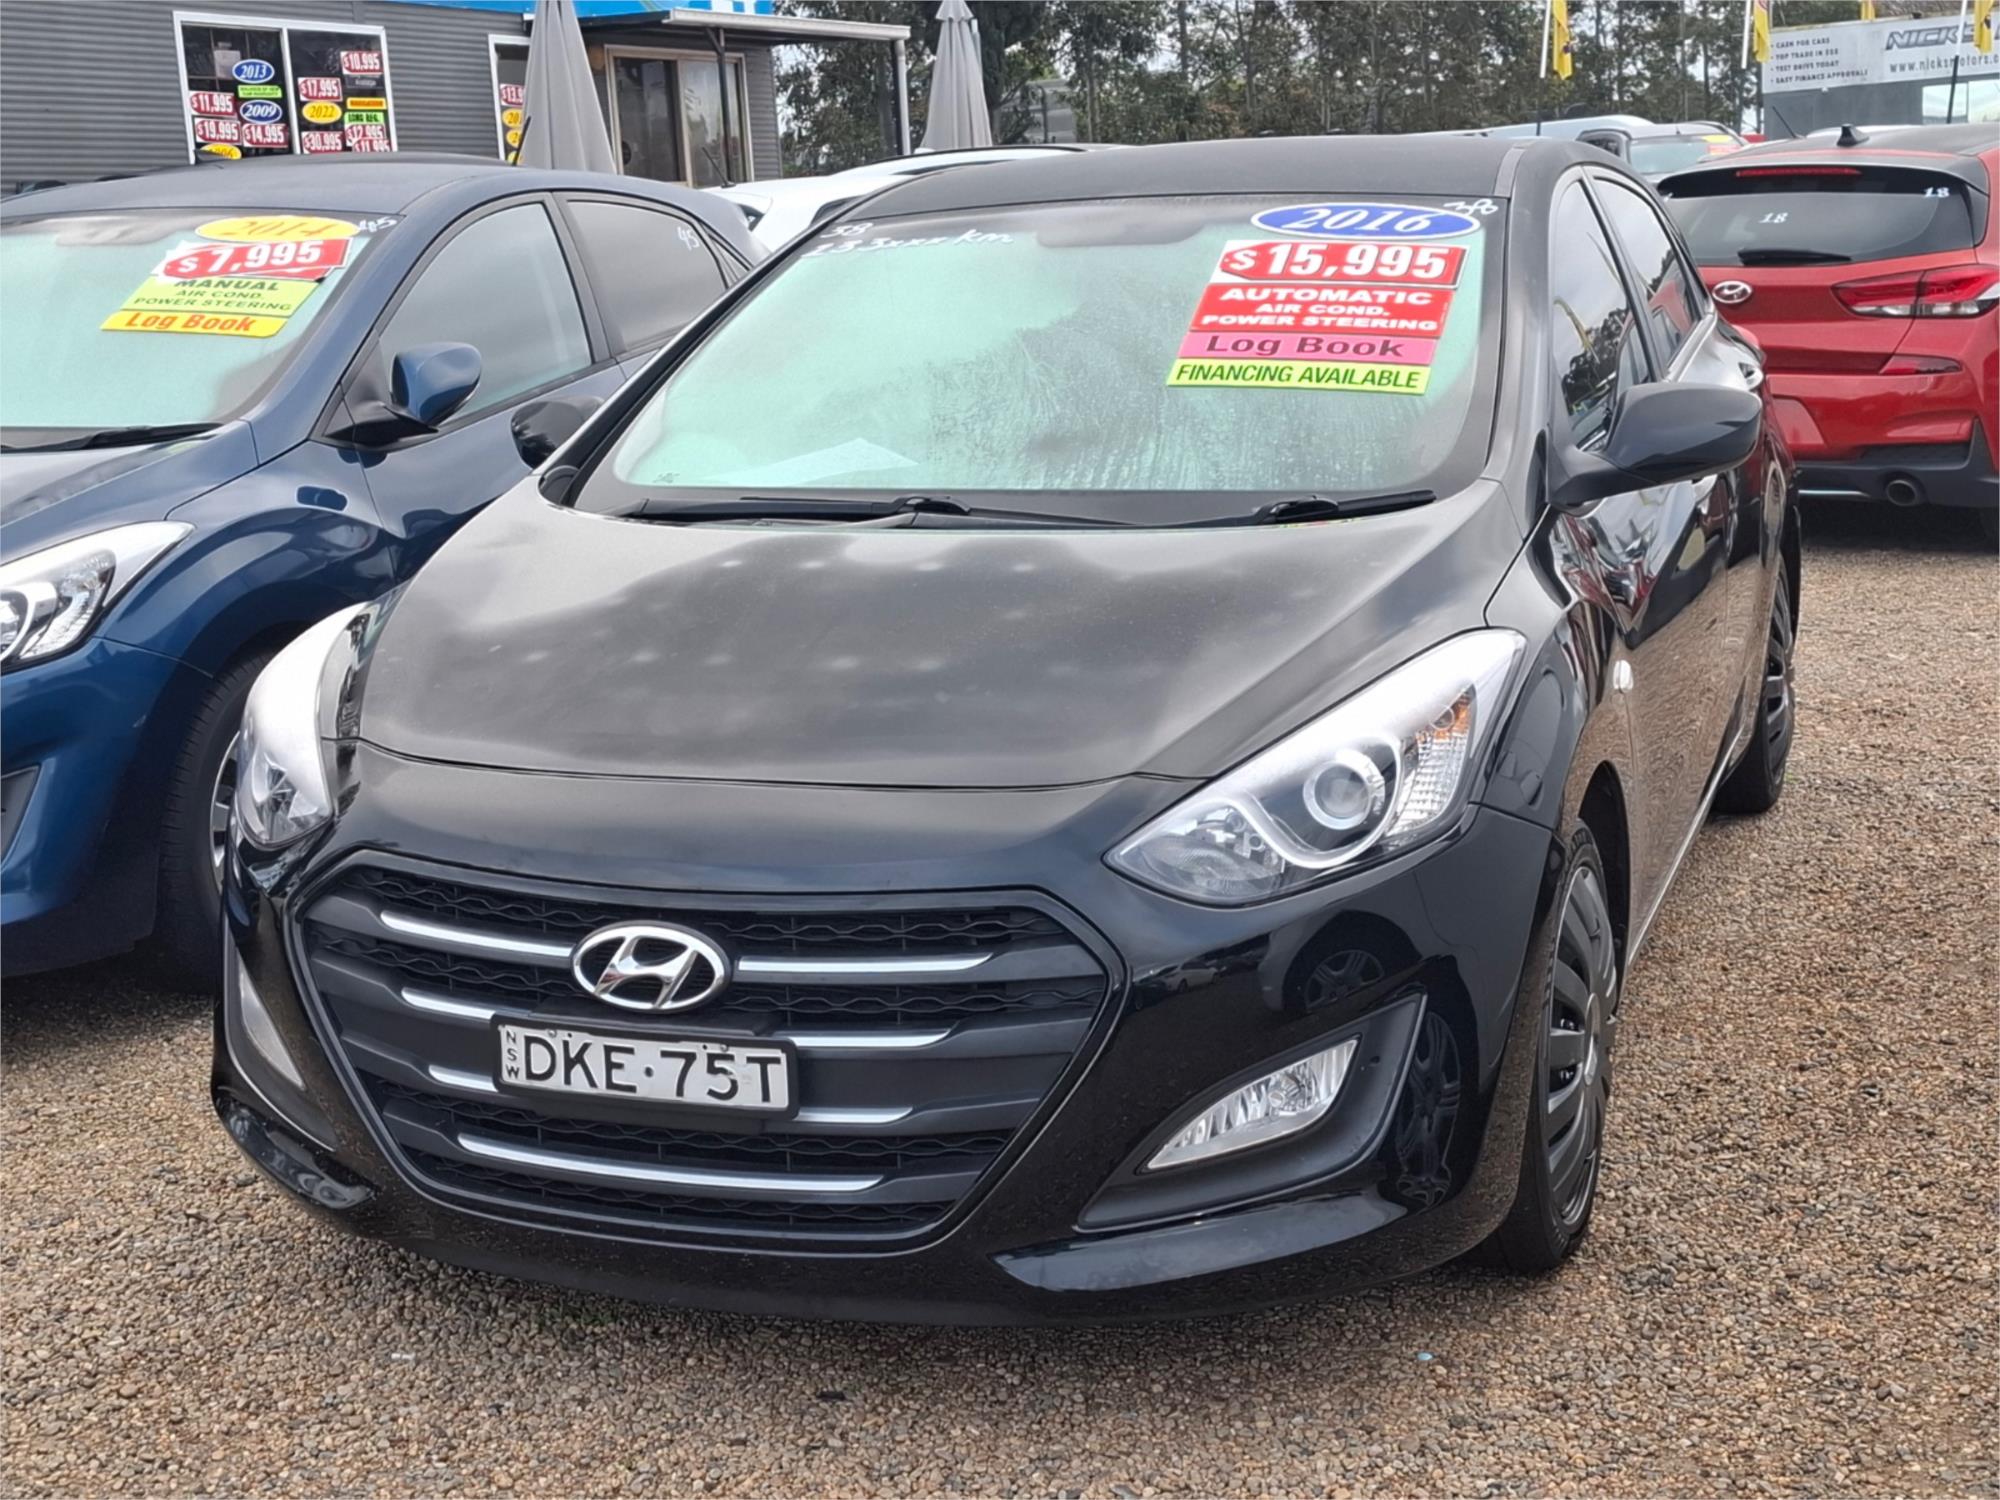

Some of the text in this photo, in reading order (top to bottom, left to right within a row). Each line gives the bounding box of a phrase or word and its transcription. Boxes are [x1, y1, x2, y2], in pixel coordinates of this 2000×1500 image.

[241, 64, 268, 79] 2013
[301, 79, 339, 98] $17,995
[191, 93, 233, 113] $11,995
[245, 104, 277, 118] 2009
[309, 105, 336, 119] 2022
[196, 120, 239, 141] $19,995
[244, 125, 285, 144] $14,995
[1924, 186, 1950, 199] 18
[1281, 208, 1448, 233] 2016
[1758, 212, 1788, 224] 18
[221, 220, 338, 238] 2014
[173, 279, 280, 291] MANUAL
[175, 289, 207, 297] AIR
[134, 297, 292, 312] POWER STEERING
[1219, 287, 1435, 305] AUTOMATIC
[1255, 303, 1392, 317] AIR COND.
[125, 312, 258, 332] Log Book
[1201, 314, 1439, 331] POWER STEERING
[1206, 335, 1406, 358] Log Book
[1176, 363, 1422, 389] FINANCING AVAILABLE
